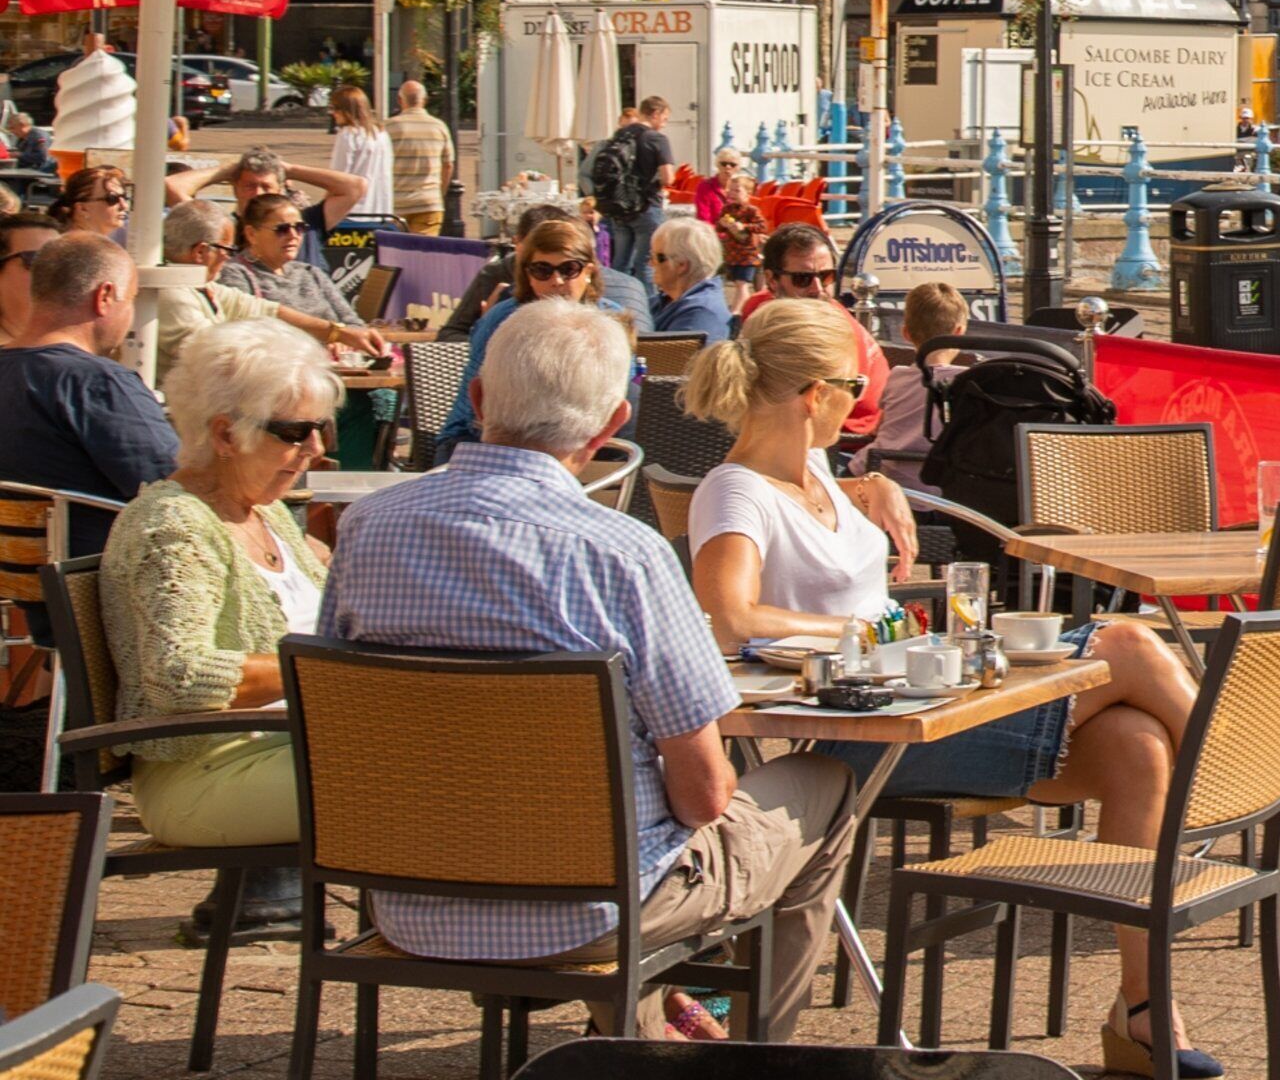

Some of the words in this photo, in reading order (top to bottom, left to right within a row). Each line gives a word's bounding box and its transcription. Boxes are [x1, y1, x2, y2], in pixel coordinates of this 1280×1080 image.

[611, 10, 693, 34] CRAB
[1084, 45, 1171, 64] SALCOMBE
[1177, 47, 1227, 65] DAIRY
[731, 42, 801, 94] SEAFOOD
[1085, 70, 1111, 87] ICE
[1117, 70, 1175, 88] CREAM
[1142, 91, 1197, 113] Available
[1202, 89, 1227, 106] Here
[887, 237, 966, 263] Offshore
